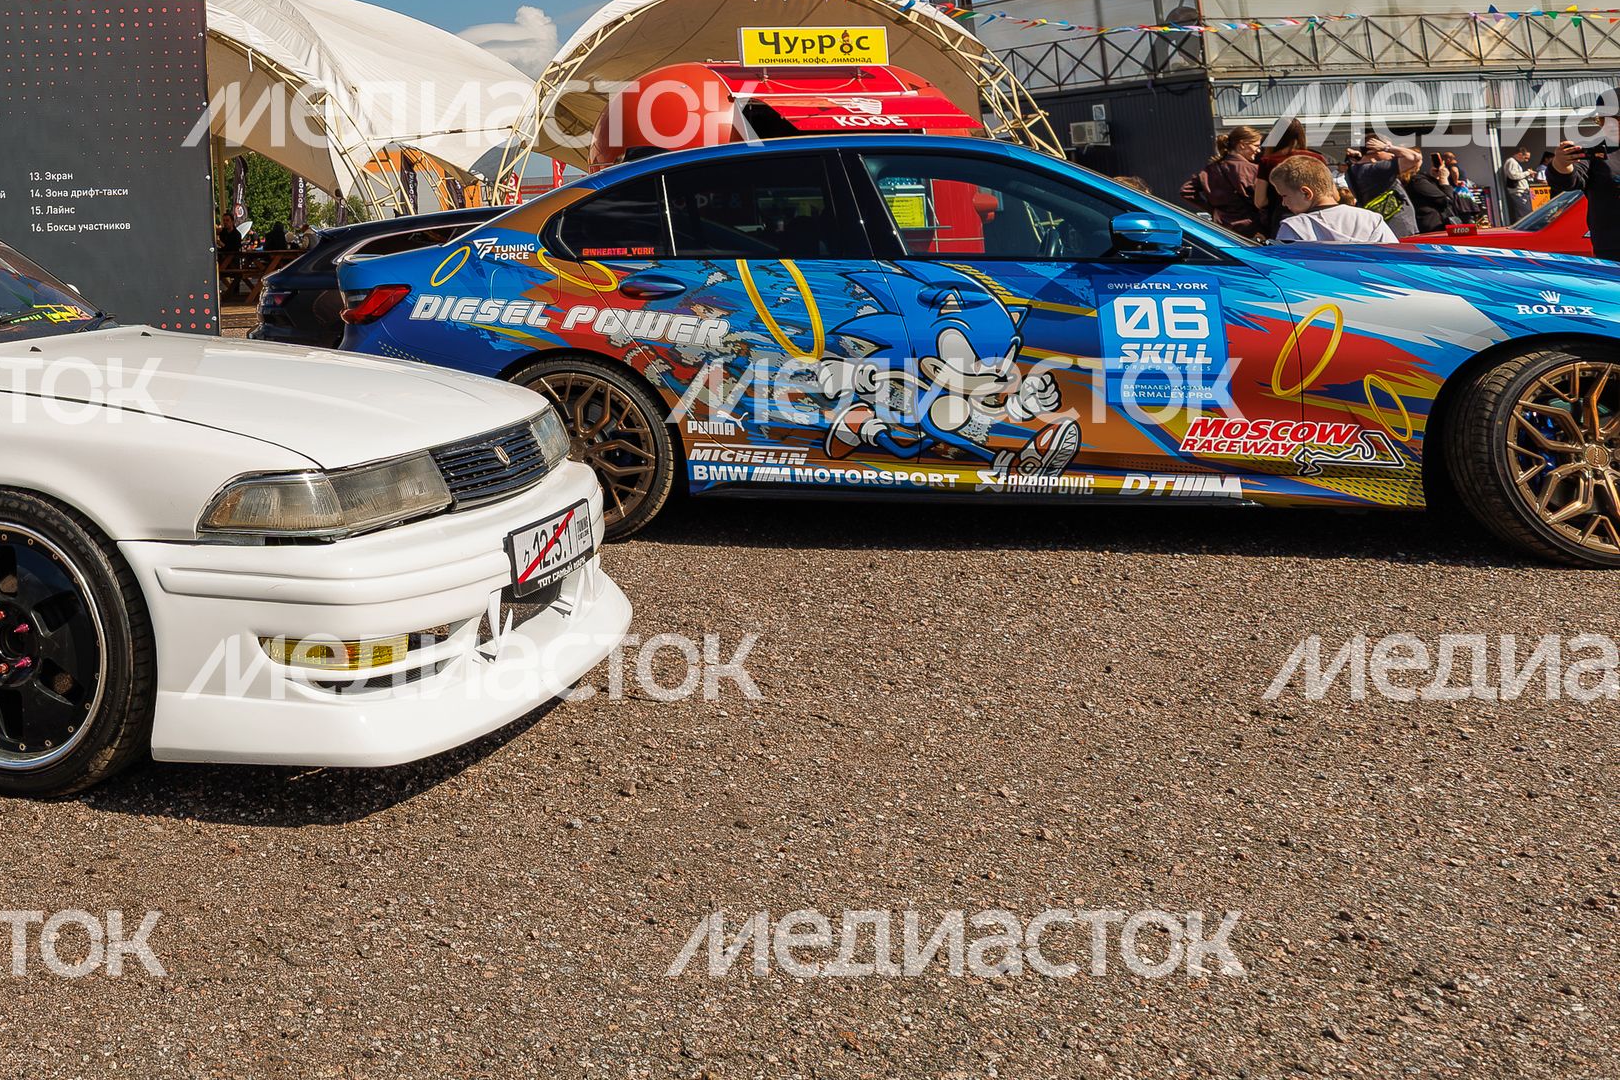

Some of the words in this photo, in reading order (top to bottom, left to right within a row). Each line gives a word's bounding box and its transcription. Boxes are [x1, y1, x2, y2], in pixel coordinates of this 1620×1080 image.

[803, 56, 829, 64] кофе,
[830, 55, 872, 64] лимонад
[833, 116, 909, 127] КОФЕ
[29, 172, 43, 181] 13.
[44, 171, 74, 182] Экран
[30, 189, 43, 198] 14.
[45, 188, 69, 198] Зона
[70, 187, 129, 199] дрифт-такси
[30, 206, 44, 215] 15.
[45, 205, 76, 215] Лайнс
[31, 223, 44, 232] 16.
[46, 222, 76, 232] Боксы
[78, 221, 131, 233] участников
[494, 243, 535, 254] TUNING
[494, 251, 529, 261] FORCE
[1107, 282, 1209, 290] @WHEATEN_YORK
[1515, 304, 1597, 317] ROLEX
[409, 294, 553, 328] DIESEL
[561, 305, 732, 348] POWER
[1113, 297, 1210, 339] 06
[1119, 343, 1213, 364] SKILL
[1123, 391, 1213, 399] BARMALEY.PRO
[687, 420, 736, 436] PUMA
[1187, 417, 1360, 445] MOSCOW
[1179, 438, 1296, 457] RACEWAY
[688, 448, 808, 465] MICHELIN
[693, 465, 749, 482] BMW
[793, 467, 960, 488] MOTORSPORT
[537, 575, 552, 588] ТОТ
